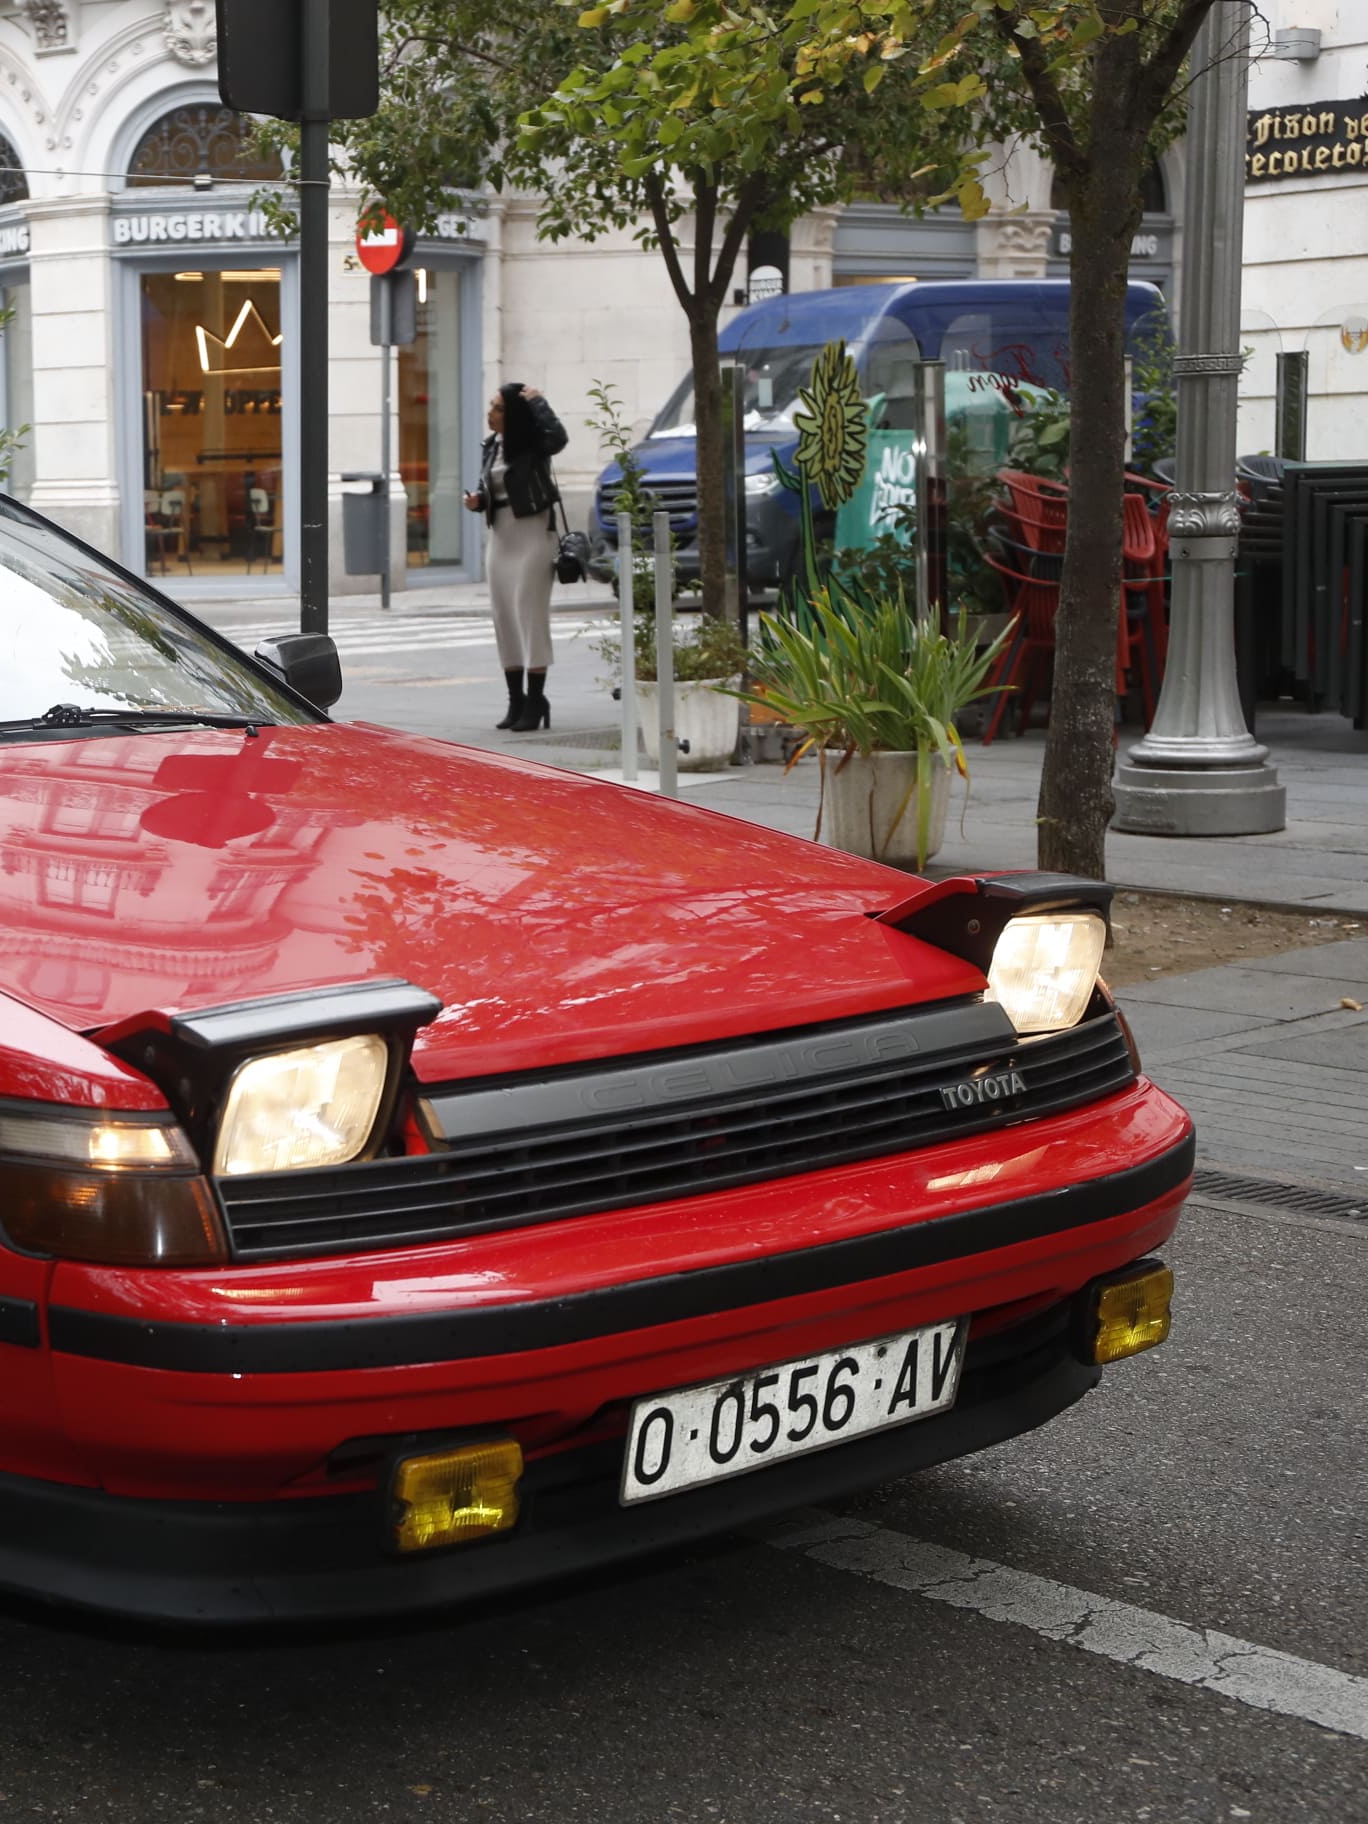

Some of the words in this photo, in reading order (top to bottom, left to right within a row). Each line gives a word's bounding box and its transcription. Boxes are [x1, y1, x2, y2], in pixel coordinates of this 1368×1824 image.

[1245, 138, 1368, 180] ecoleto
[114, 213, 222, 243] BURGER
[881, 446, 917, 484] NO
[578, 1030, 922, 1112] CELICA
[940, 1072, 1028, 1111] TOYOTA
